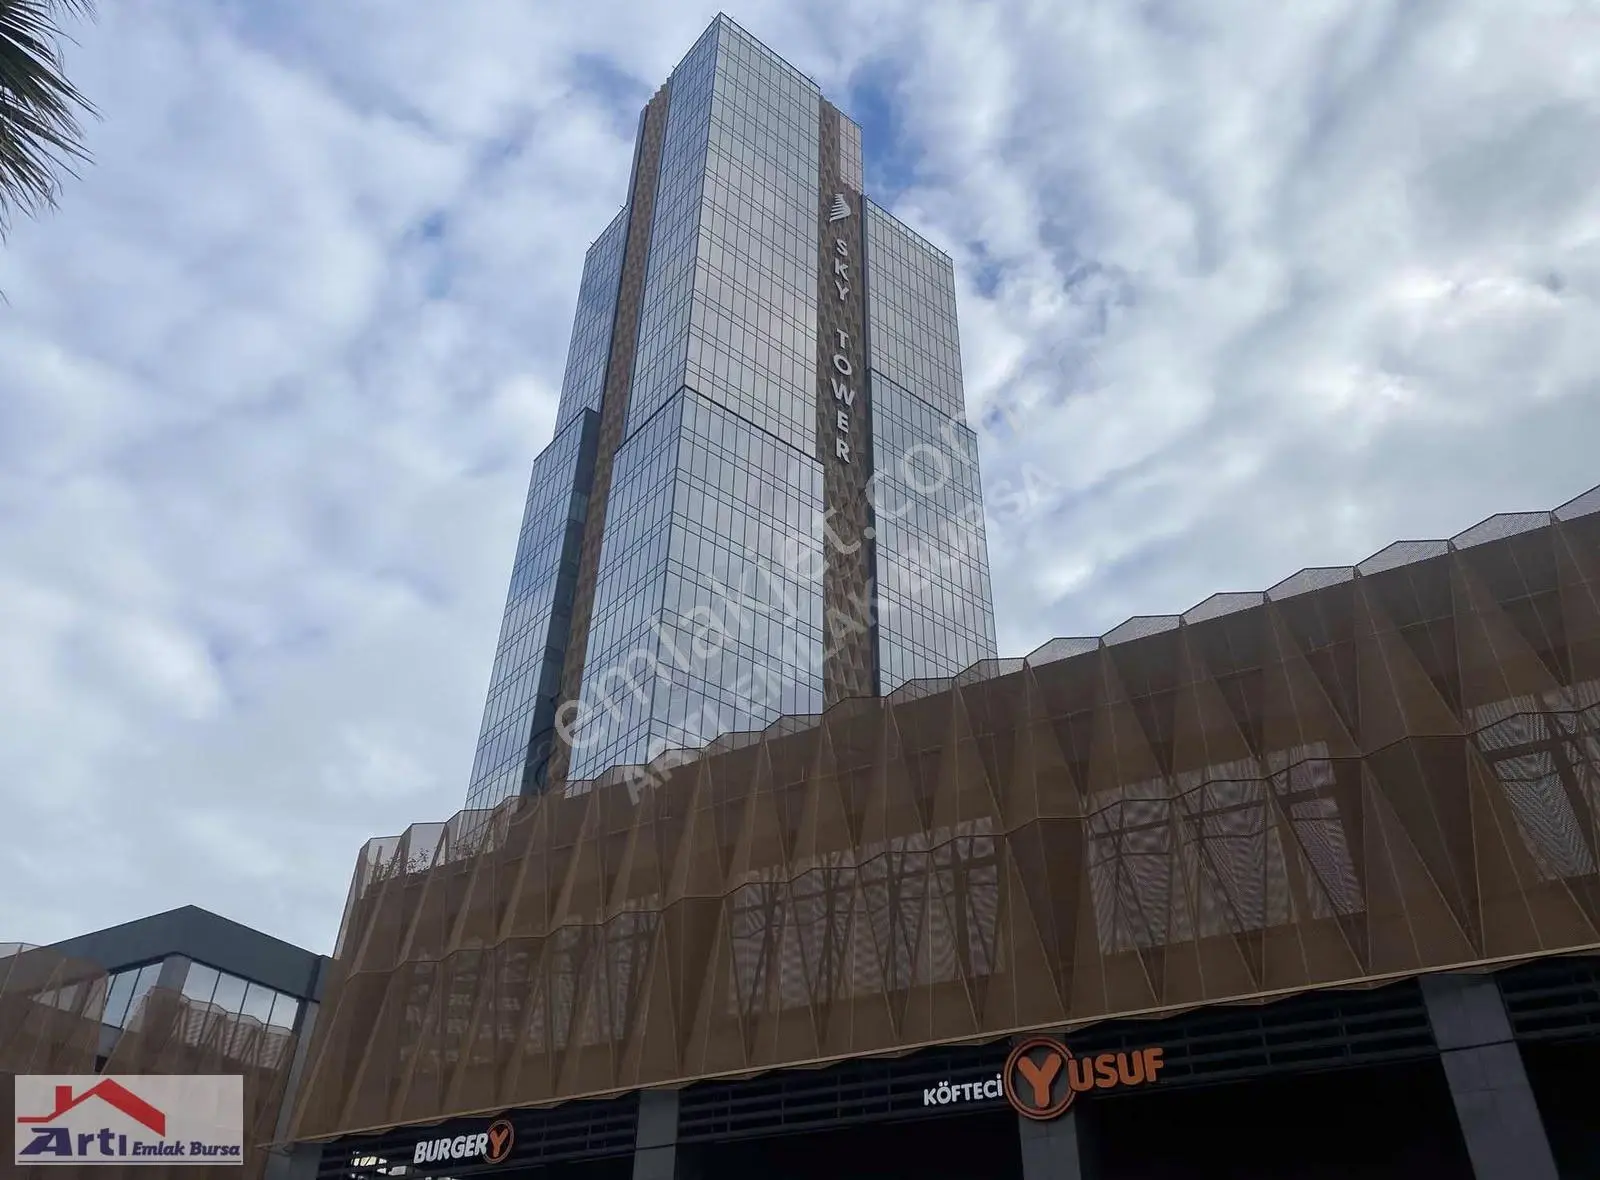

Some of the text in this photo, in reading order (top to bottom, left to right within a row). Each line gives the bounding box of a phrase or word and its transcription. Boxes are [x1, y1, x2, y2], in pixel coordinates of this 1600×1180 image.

[830, 238, 855, 464] SKY TOWER
[923, 1048, 1164, 1107] KÖFTECİ YUSUF
